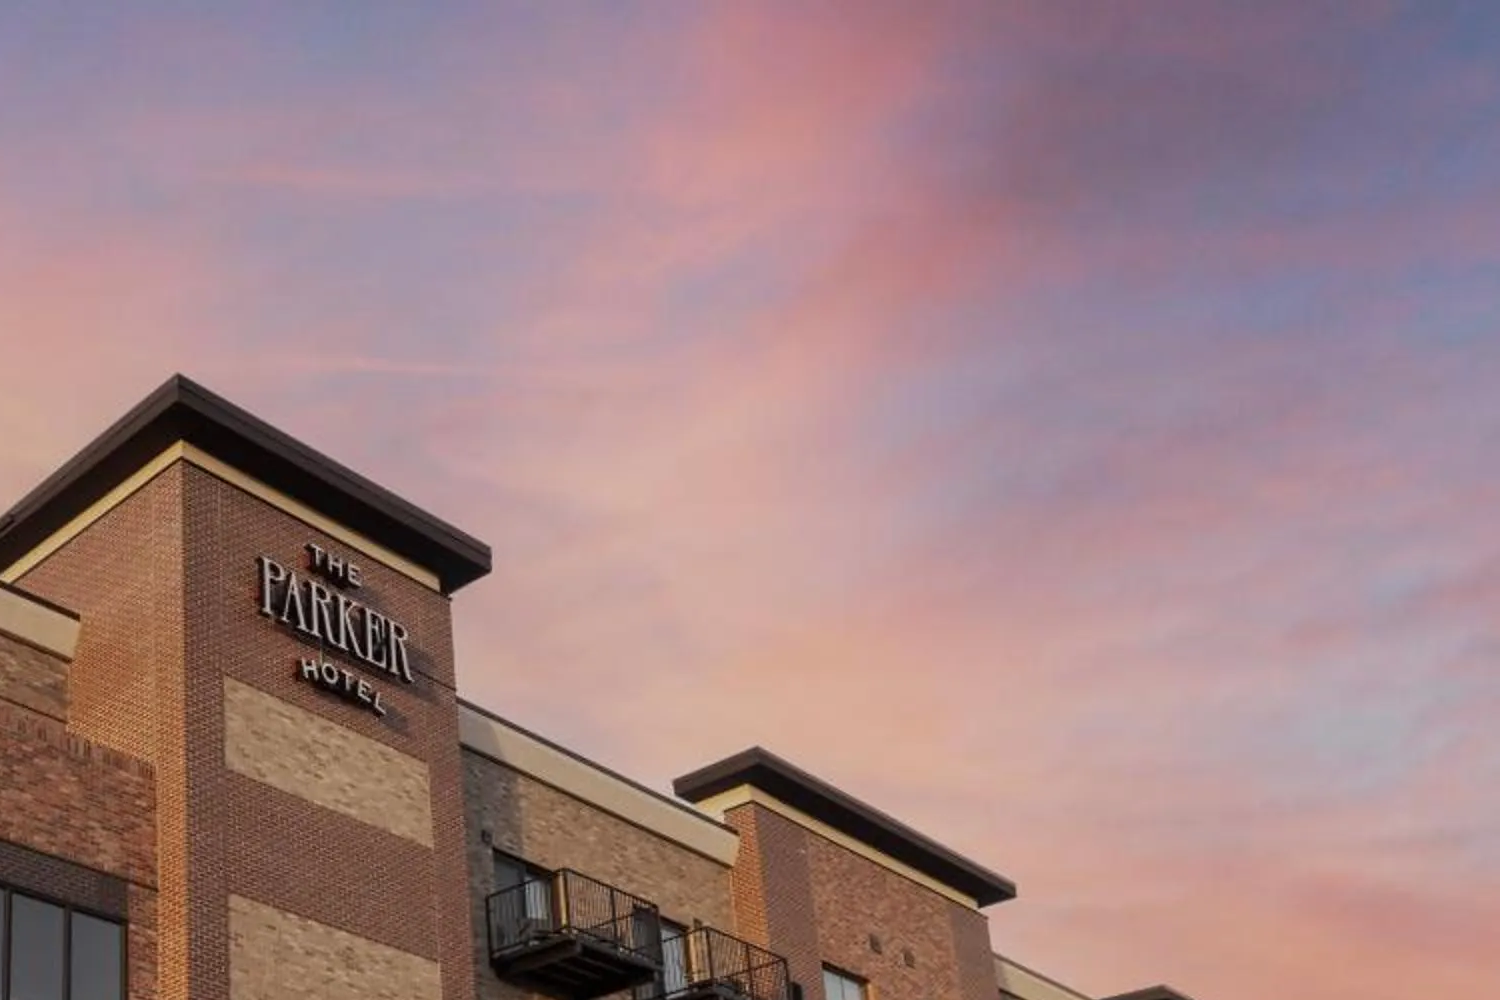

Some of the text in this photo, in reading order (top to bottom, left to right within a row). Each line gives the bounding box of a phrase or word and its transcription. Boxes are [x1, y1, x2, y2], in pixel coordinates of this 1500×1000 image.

[307, 543, 363, 587] THE
[259, 556, 415, 683] PARKER
[301, 657, 386, 715] HOTEL
